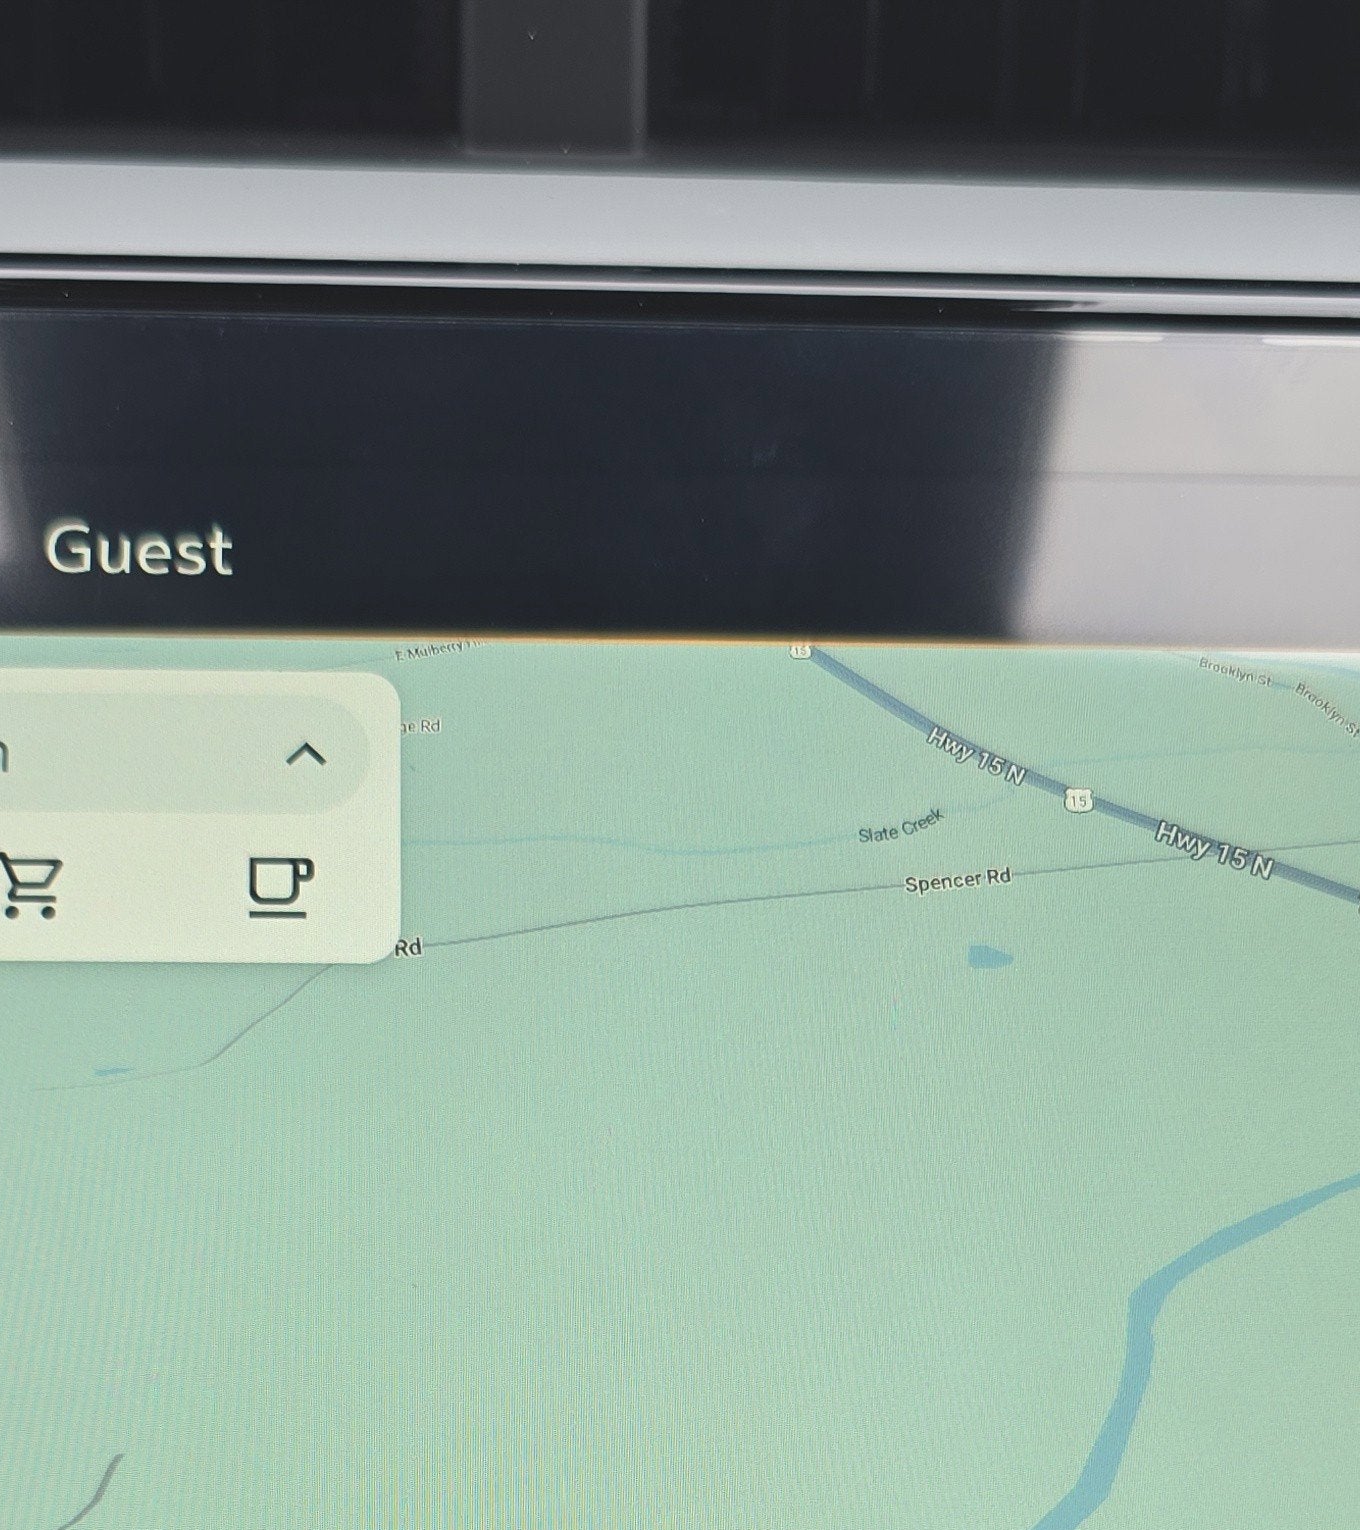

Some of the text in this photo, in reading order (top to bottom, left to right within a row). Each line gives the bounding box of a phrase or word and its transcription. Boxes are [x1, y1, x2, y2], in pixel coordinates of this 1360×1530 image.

[45, 522, 235, 577] Guest
[1198, 657, 1273, 688] Brooklyn St
[421, 719, 441, 733] Rd
[1294, 681, 1360, 738] Brooklyn St
[926, 725, 1028, 787] Hwy 15 N
[1071, 795, 1087, 808] 15
[858, 807, 946, 844] Slate Creek
[1155, 820, 1275, 880] Hwy 15 N
[904, 867, 1012, 895] Spencer Rd
[395, 936, 422, 957] Rd
